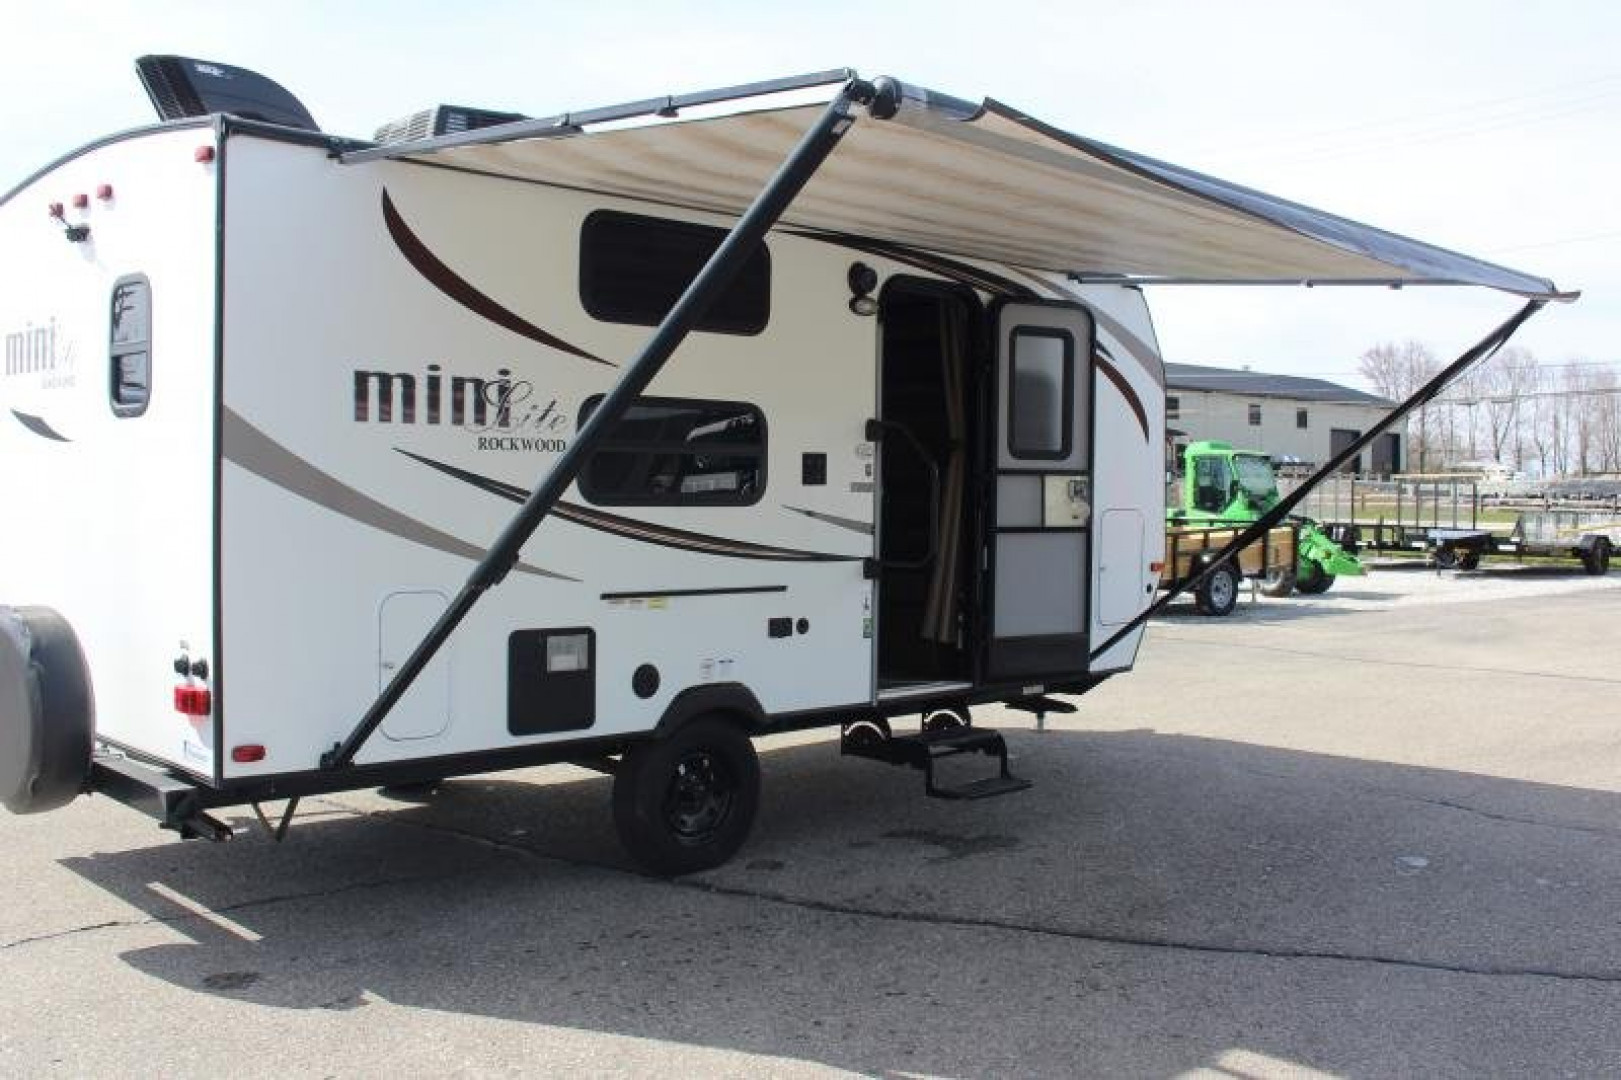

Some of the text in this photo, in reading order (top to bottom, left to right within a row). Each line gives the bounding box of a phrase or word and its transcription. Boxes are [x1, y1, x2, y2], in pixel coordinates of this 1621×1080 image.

[6, 317, 56, 375] mini
[354, 364, 565, 433] mini Lite
[478, 437, 566, 452] ROCKWOOD
